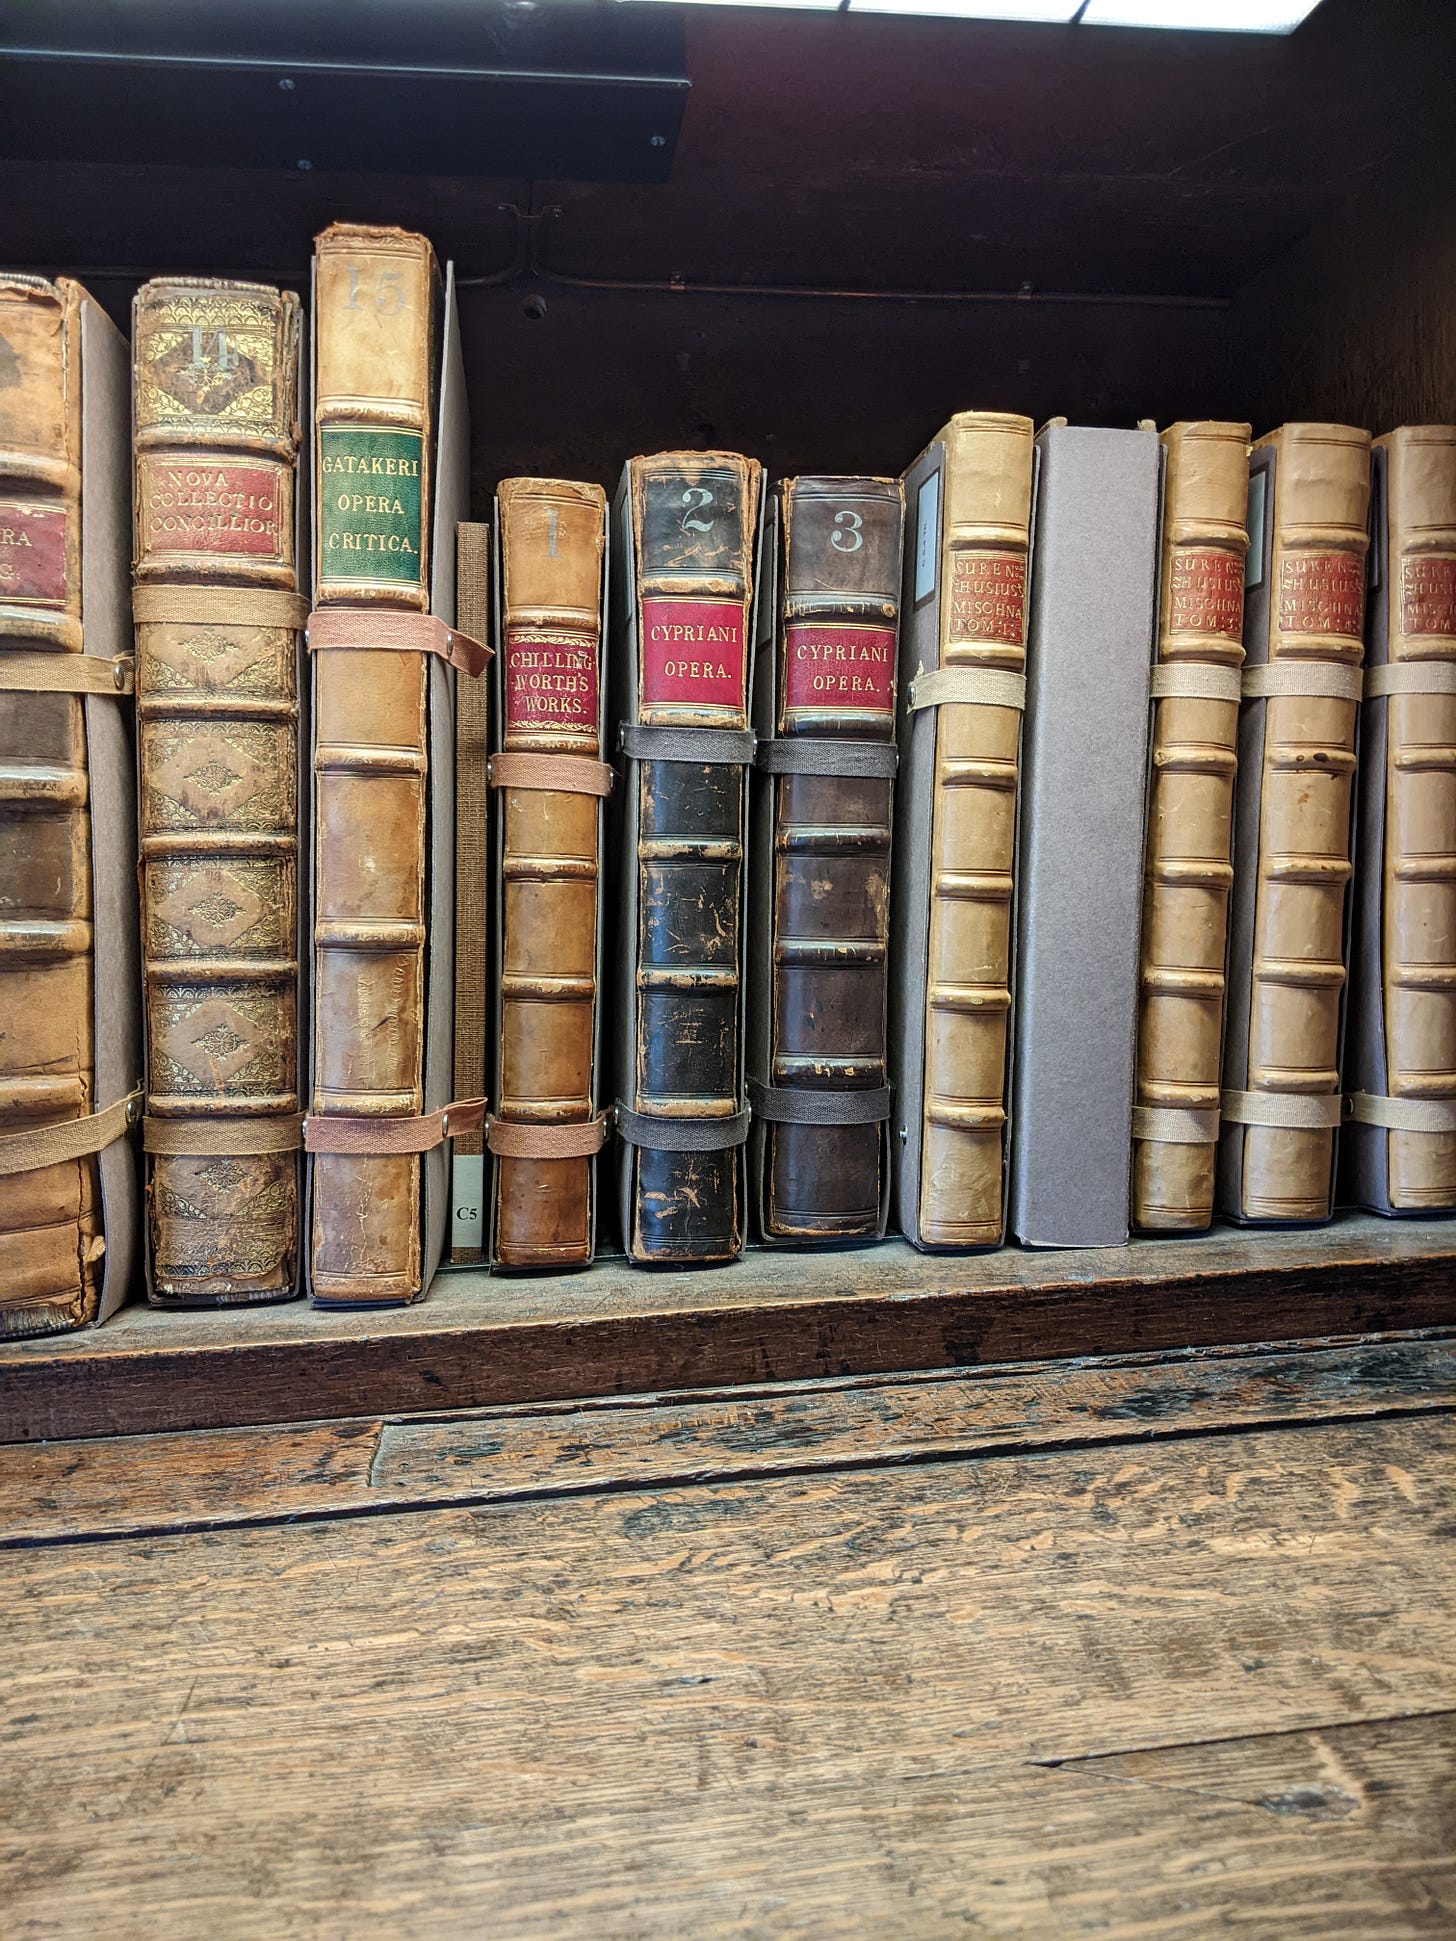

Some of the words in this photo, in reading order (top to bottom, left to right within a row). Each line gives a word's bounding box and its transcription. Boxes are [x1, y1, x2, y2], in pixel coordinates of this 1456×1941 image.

[342, 263, 405, 317] 15
[322, 455, 418, 477] GATAKERI
[167, 471, 229, 487] NOVA
[149, 490, 273, 512] COLLECTIO
[337, 493, 405, 514] OPERA
[681, 487, 714, 533] 2
[0, 527, 33, 547] RA
[830, 510, 863, 553] 3
[328, 531, 418, 554] CRITICA.
[650, 624, 738, 643] CYPRIANI
[796, 644, 889, 664] CYPRIANI
[664, 661, 733, 679] OPERA.
[812, 674, 881, 692] OPERA.
[524, 695, 588, 715] WORKS.
[456, 1206, 478, 1221] C5
